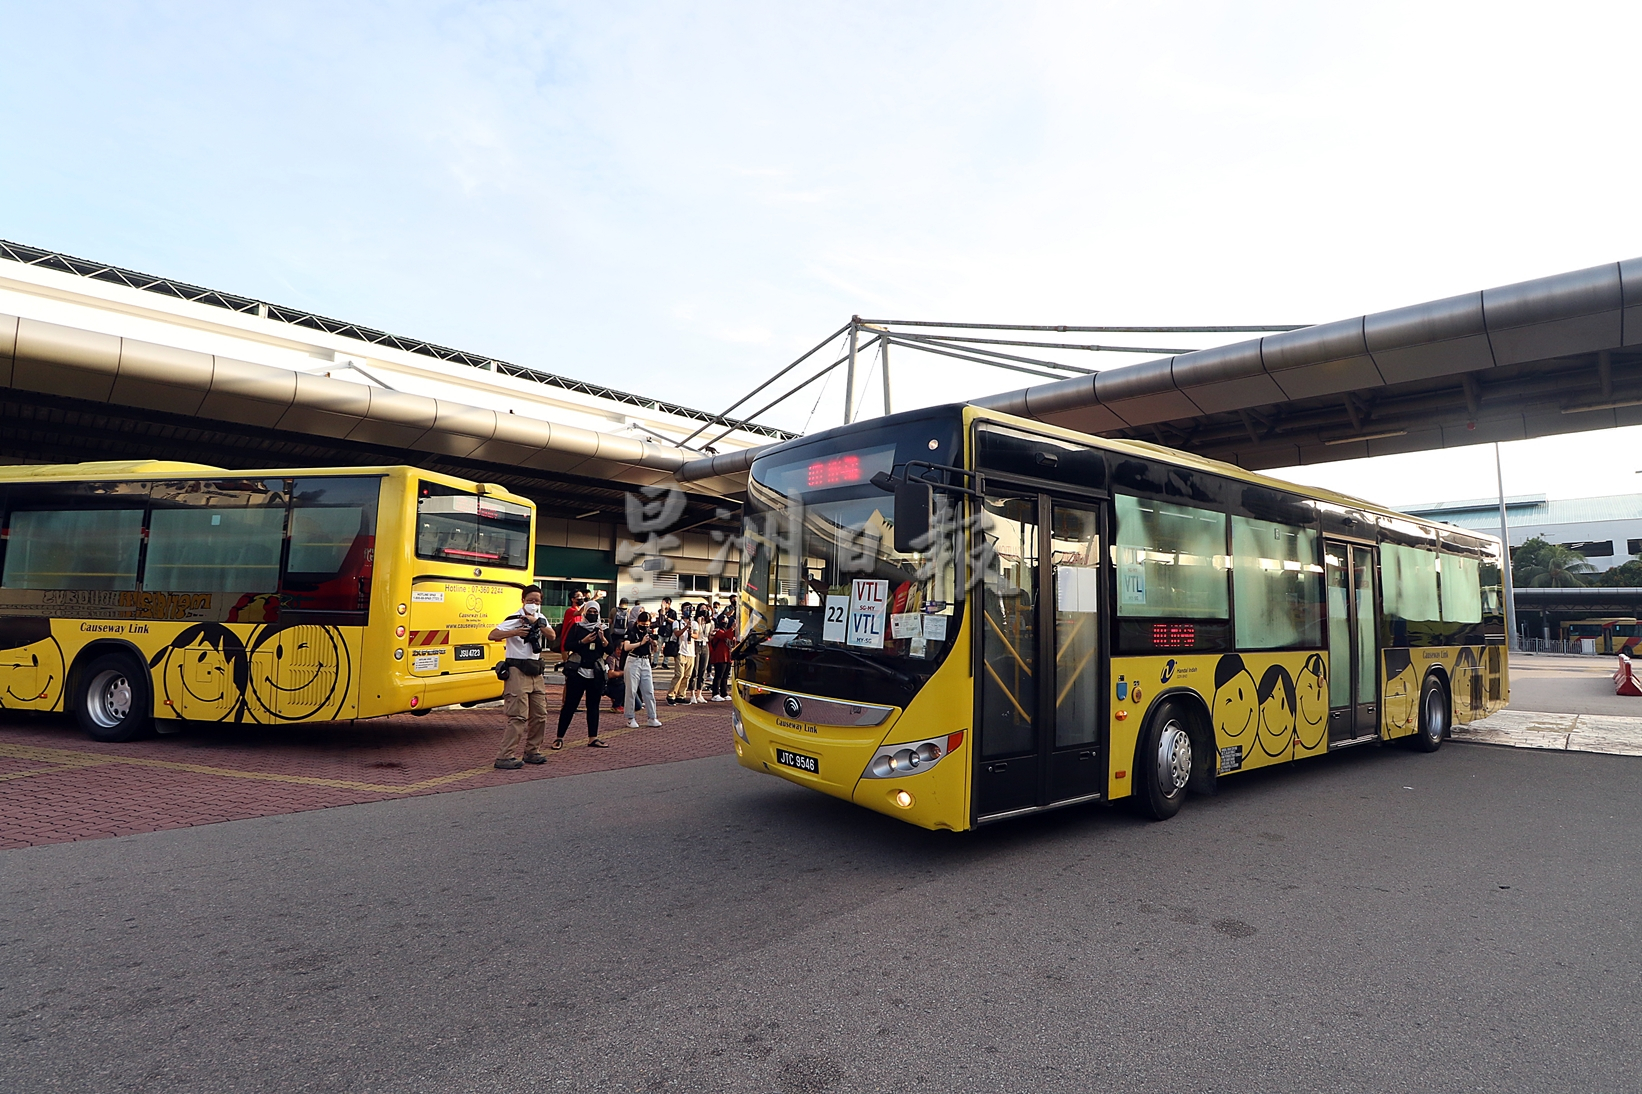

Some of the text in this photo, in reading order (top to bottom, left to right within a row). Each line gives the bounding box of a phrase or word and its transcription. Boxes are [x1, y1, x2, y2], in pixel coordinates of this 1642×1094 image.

[445, 584, 467, 593] Hotline
[1125, 574, 1143, 593] VTL
[856, 581, 883, 603] VTL
[458, 612, 479, 620] Causeway
[827, 606, 844, 623] 22
[80, 622, 150, 634] Causeway Link
[853, 613, 880, 635] VTL
[1422, 650, 1441, 660] Causeway
[776, 718, 818, 734] Causeway Link
[780, 751, 815, 771] JTC 9546
